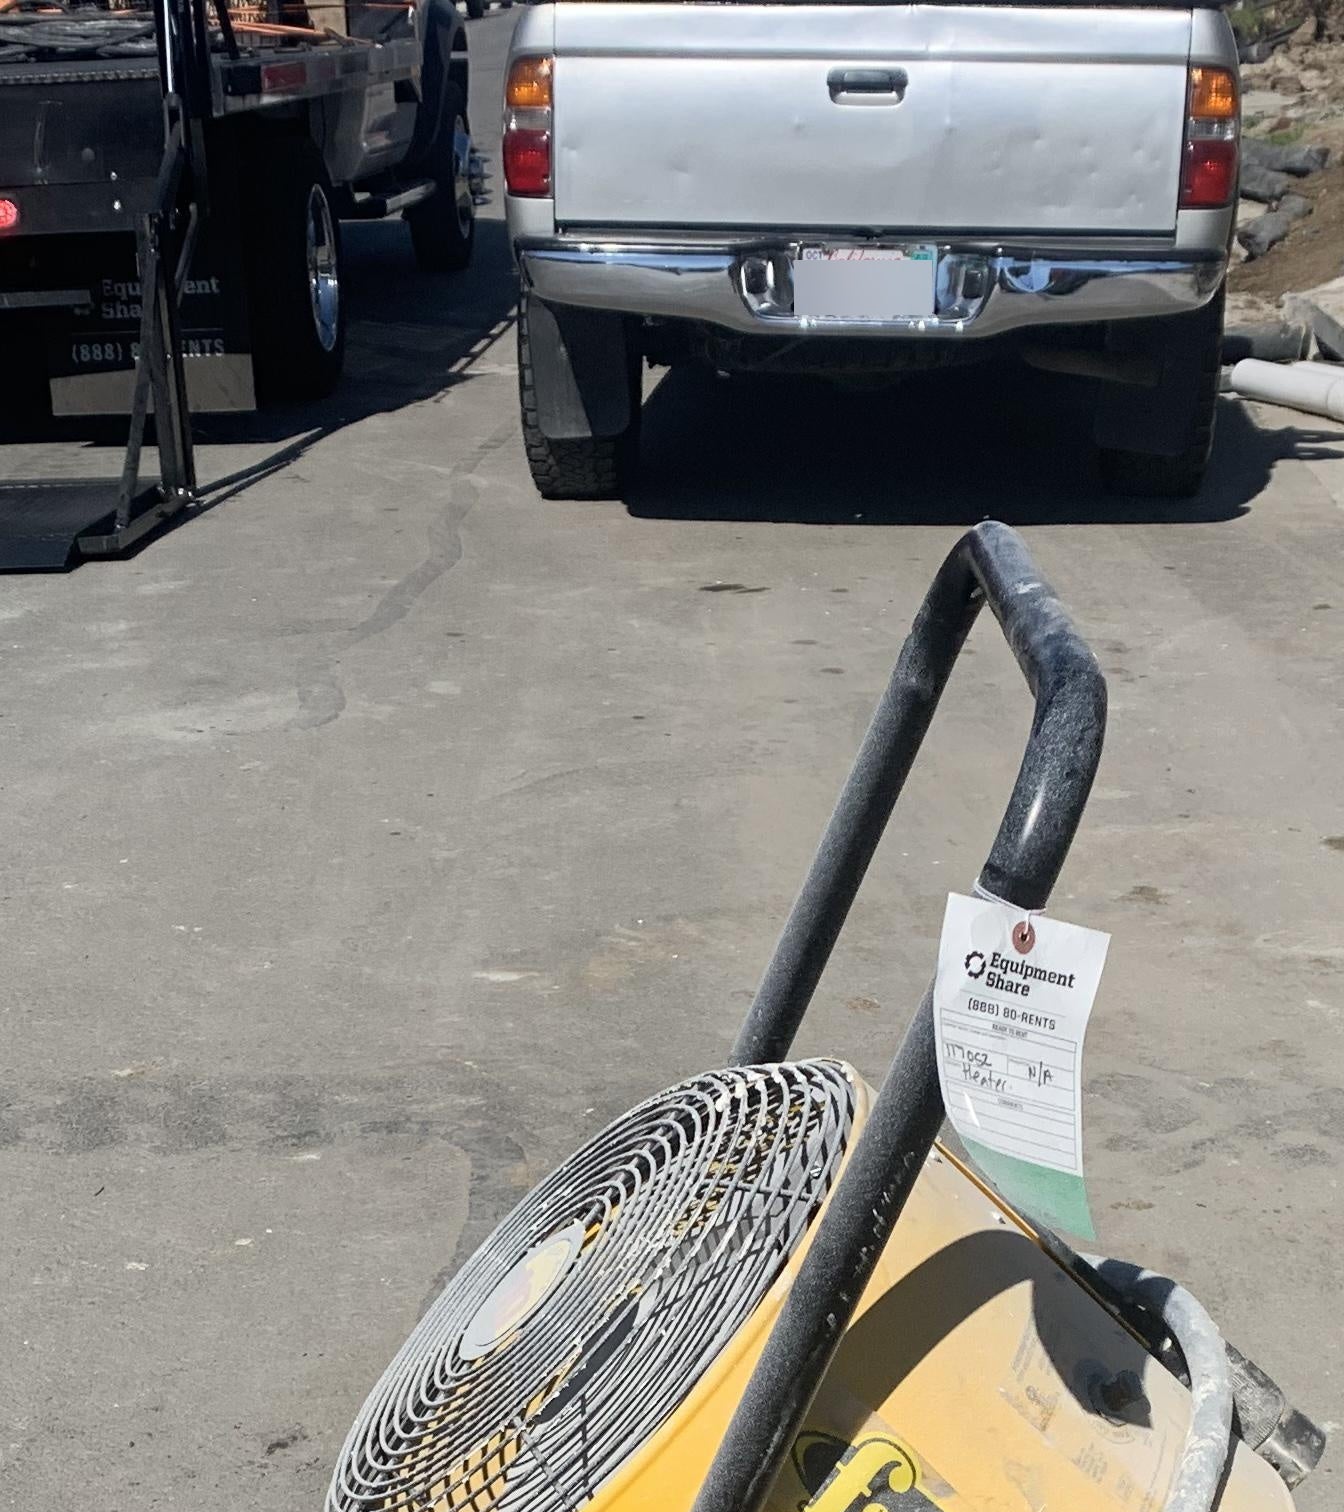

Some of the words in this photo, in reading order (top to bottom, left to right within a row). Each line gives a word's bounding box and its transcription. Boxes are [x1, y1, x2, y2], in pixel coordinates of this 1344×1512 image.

[102, 276, 220, 301] Equent
[101, 301, 144, 319] Sha
[72, 342, 123, 362] (888)
[989, 951, 1076, 988] Equipment
[985, 971, 1030, 997] Share
[968, 997, 999, 1016] (888)
[1003, 1007, 1056, 1031] 80-RENTS
[1028, 1060, 1053, 1087] N/A
